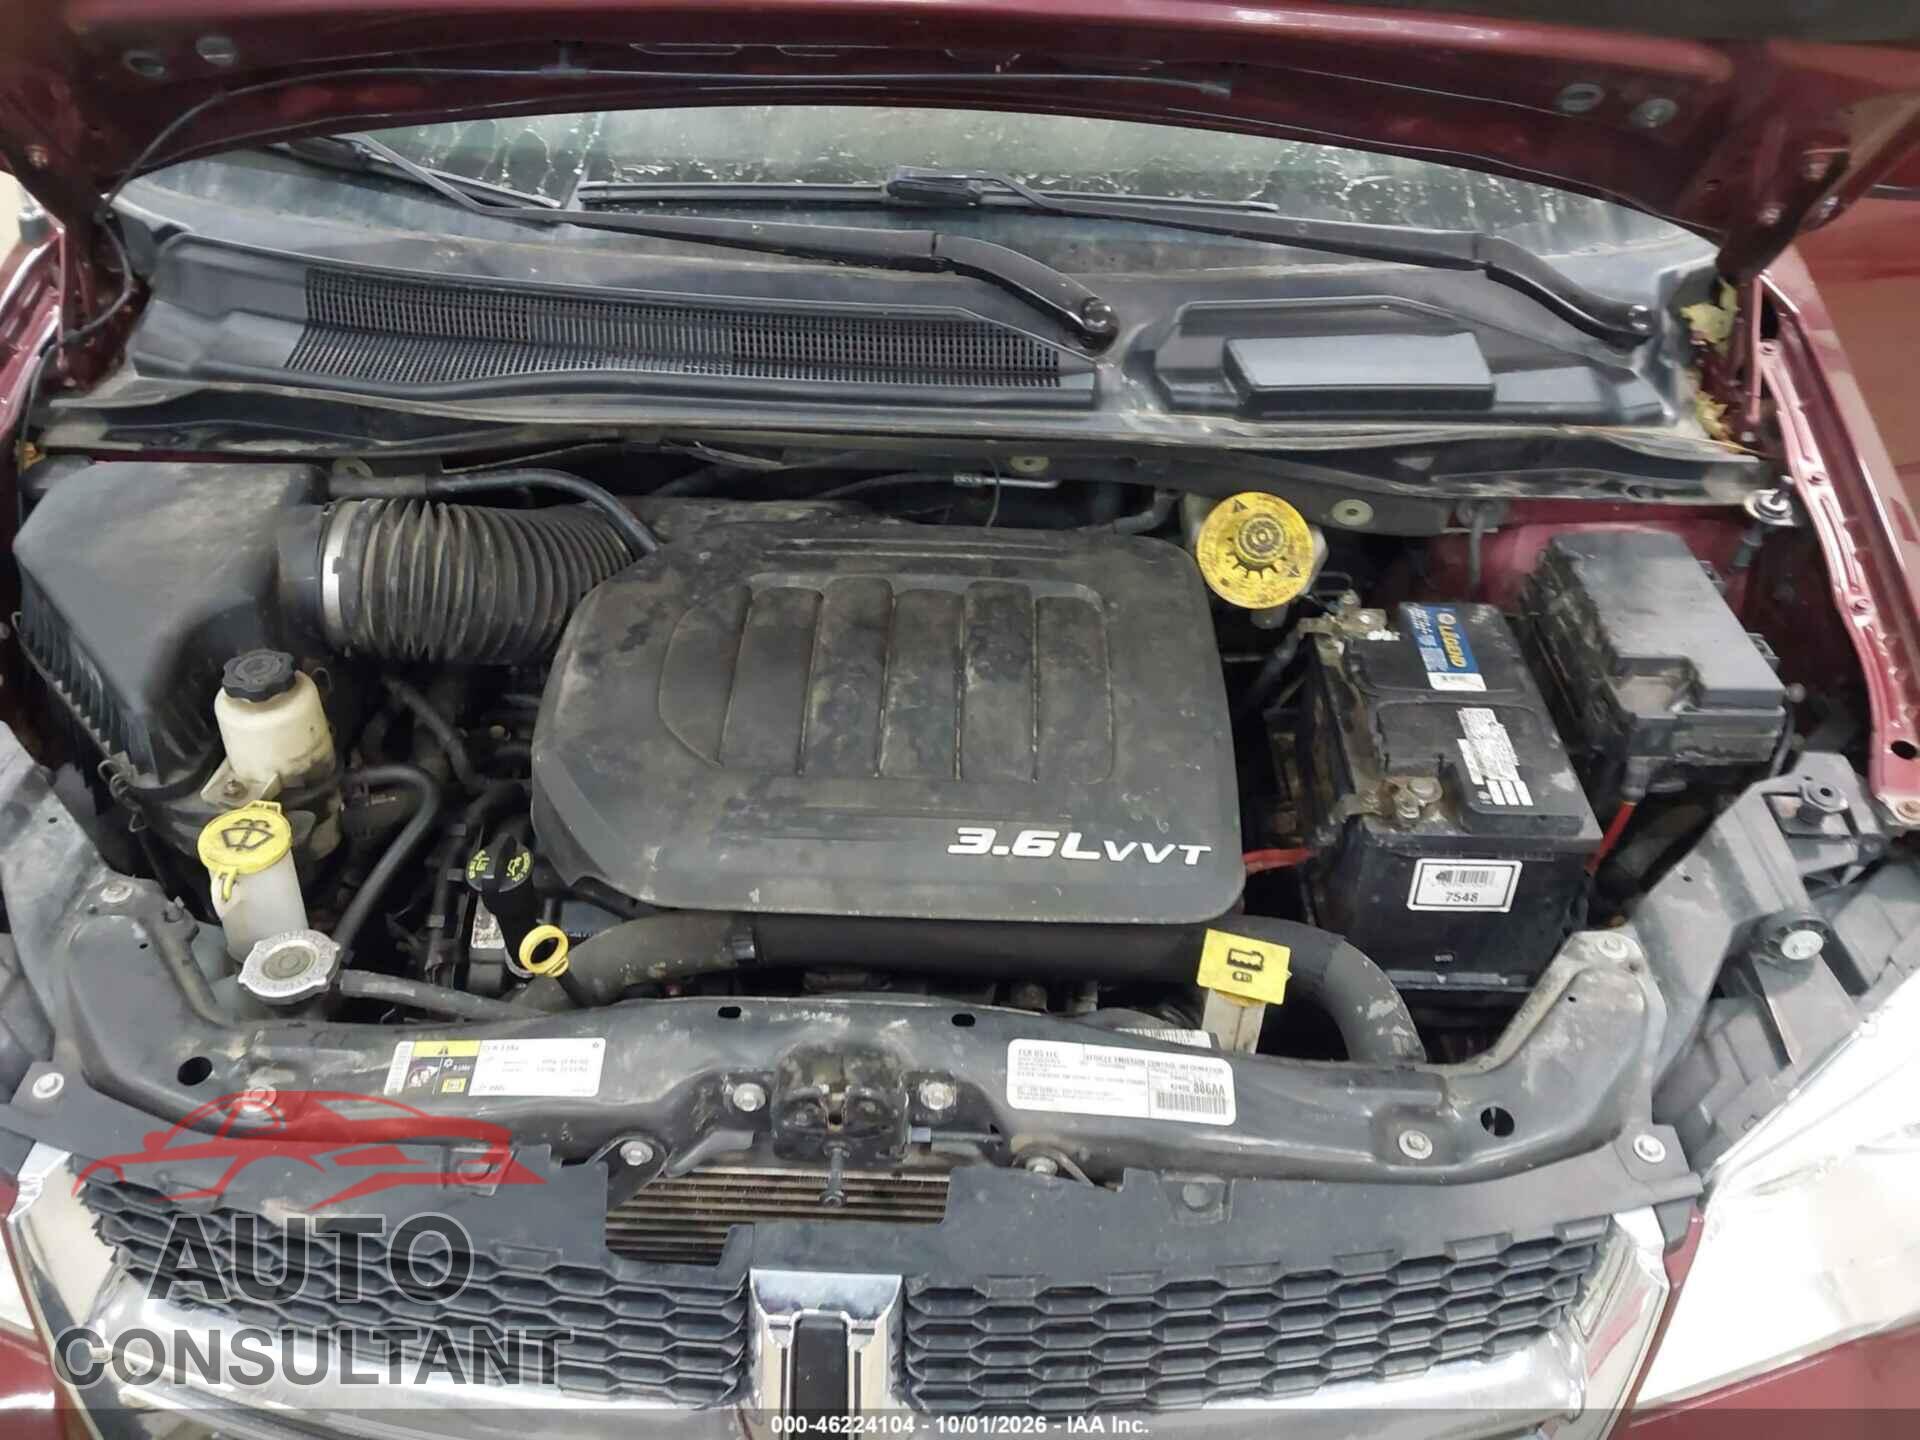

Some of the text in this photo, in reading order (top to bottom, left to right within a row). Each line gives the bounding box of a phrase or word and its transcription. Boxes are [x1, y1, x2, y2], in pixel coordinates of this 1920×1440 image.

[948, 827, 1212, 865] 3.6L VVT
[1445, 891, 1479, 903] 7548
